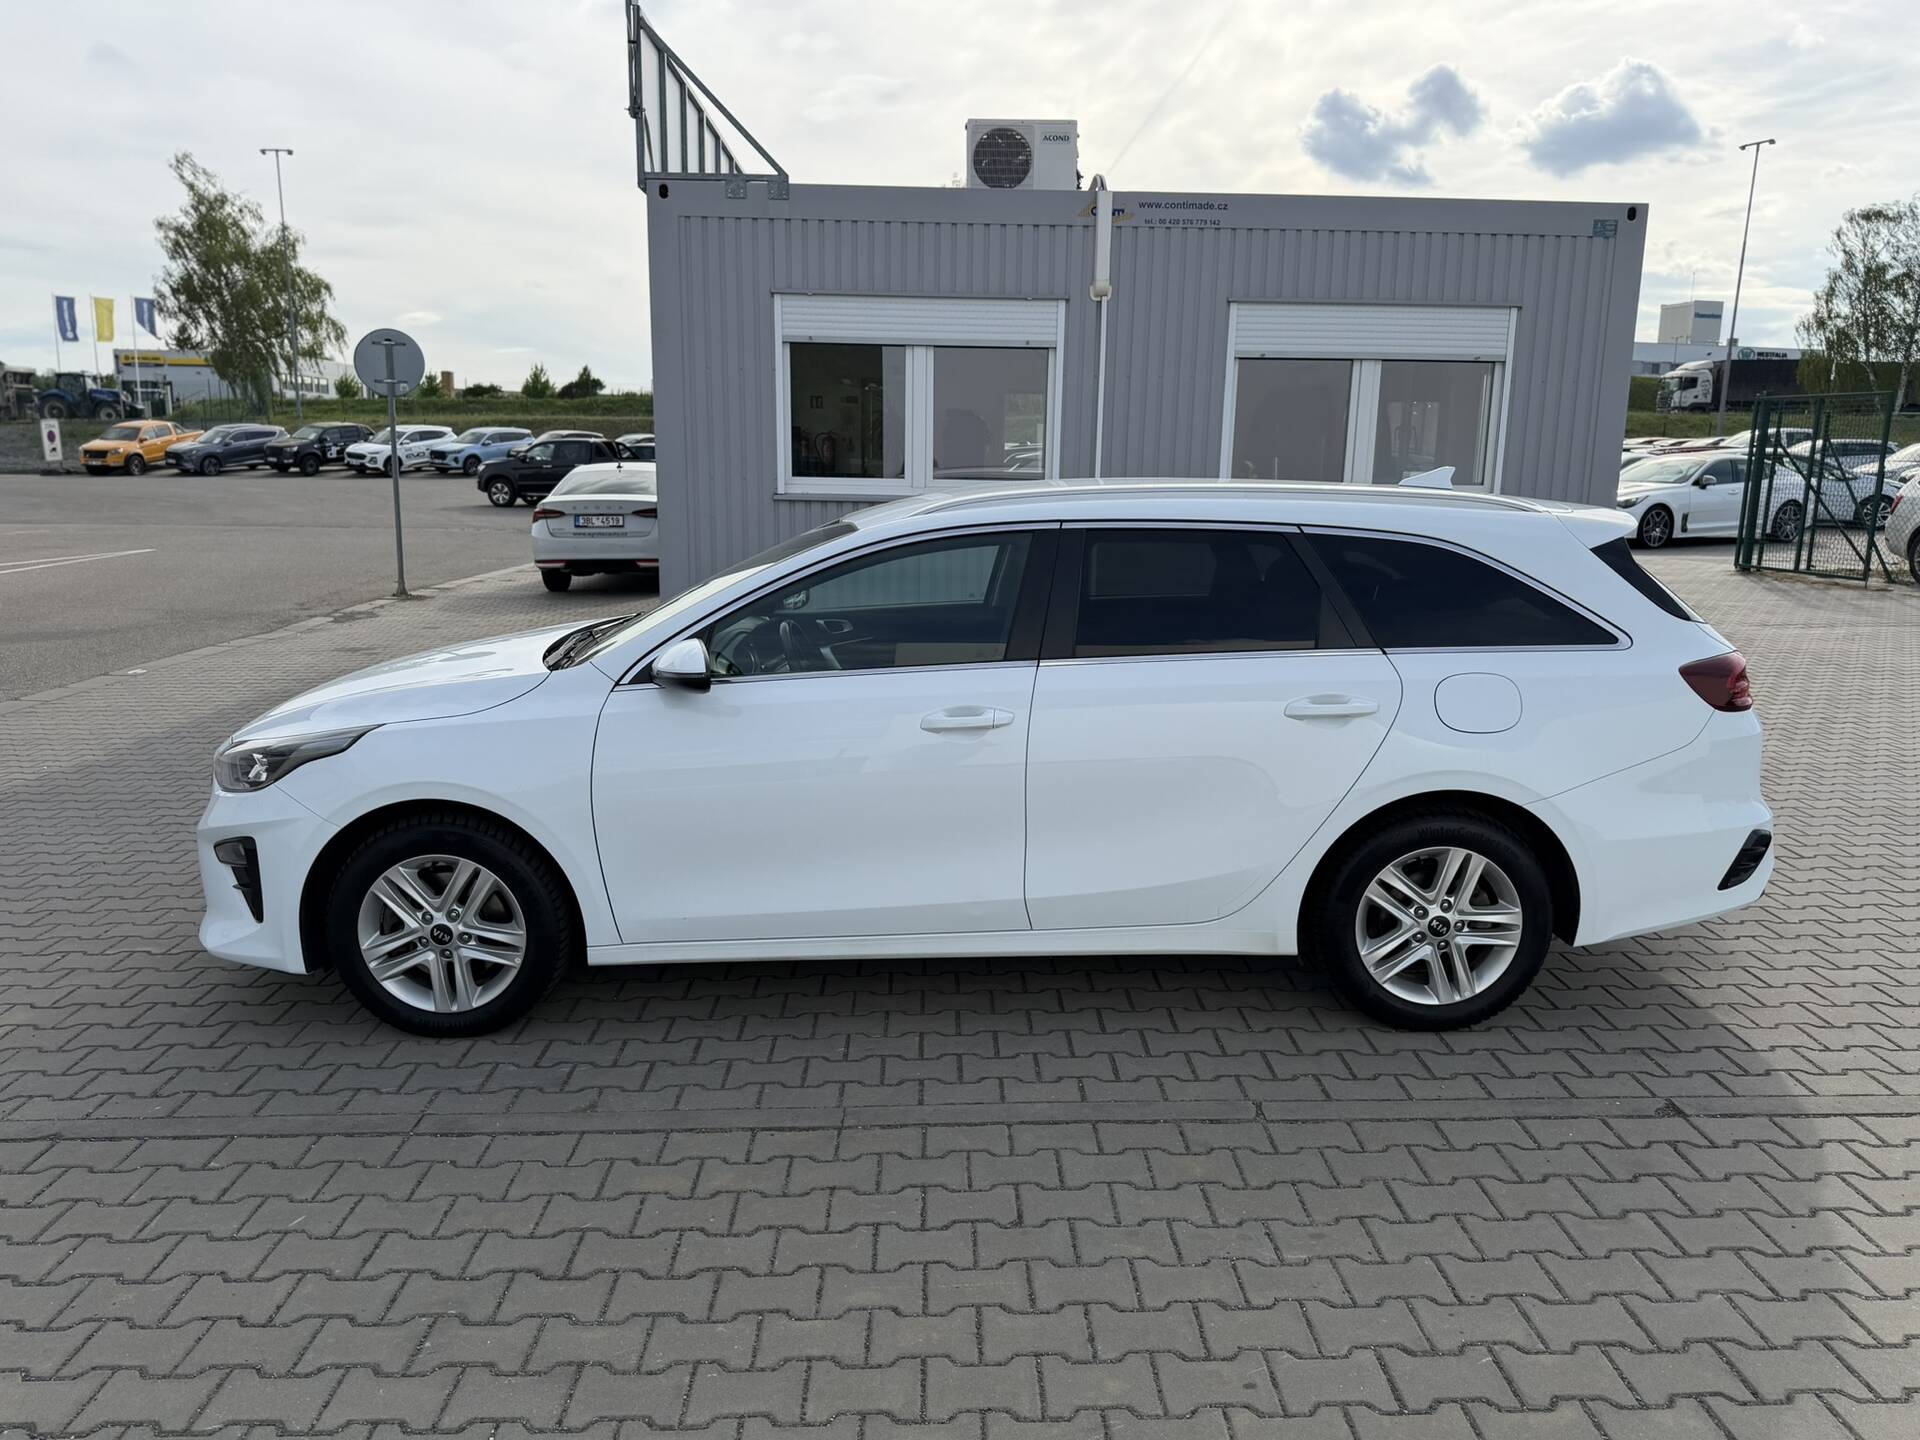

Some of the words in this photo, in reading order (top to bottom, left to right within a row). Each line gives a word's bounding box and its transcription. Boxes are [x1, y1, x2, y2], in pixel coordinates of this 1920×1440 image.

[1138, 201, 1228, 211] www.contimade.cz
[1431, 919, 1447, 935] KIA
[433, 928, 451, 942] KIA
